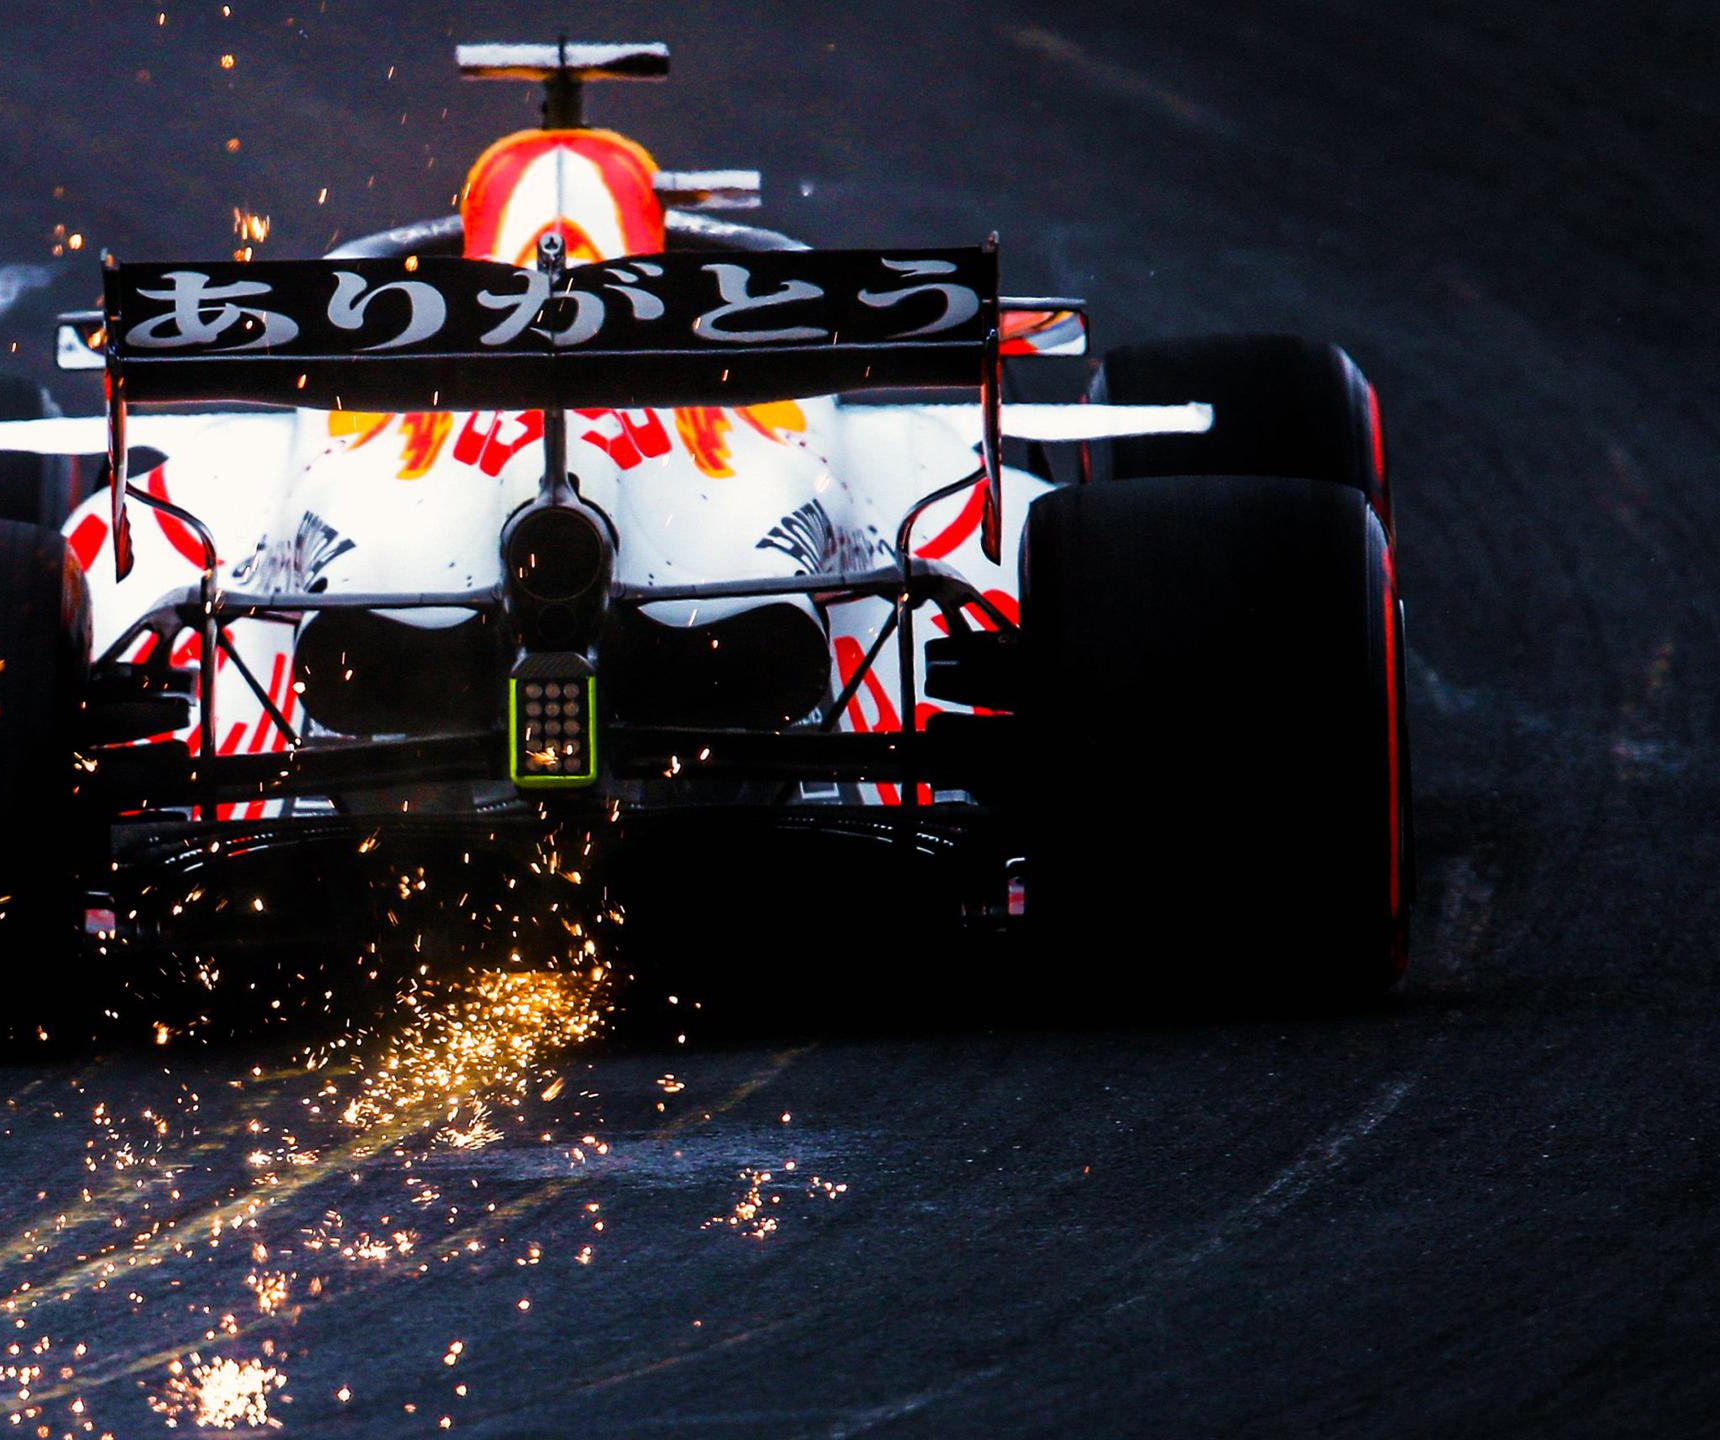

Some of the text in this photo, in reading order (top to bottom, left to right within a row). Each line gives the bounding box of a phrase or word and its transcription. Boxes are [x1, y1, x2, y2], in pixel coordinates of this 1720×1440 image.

[125, 257, 979, 352] ありがとう
